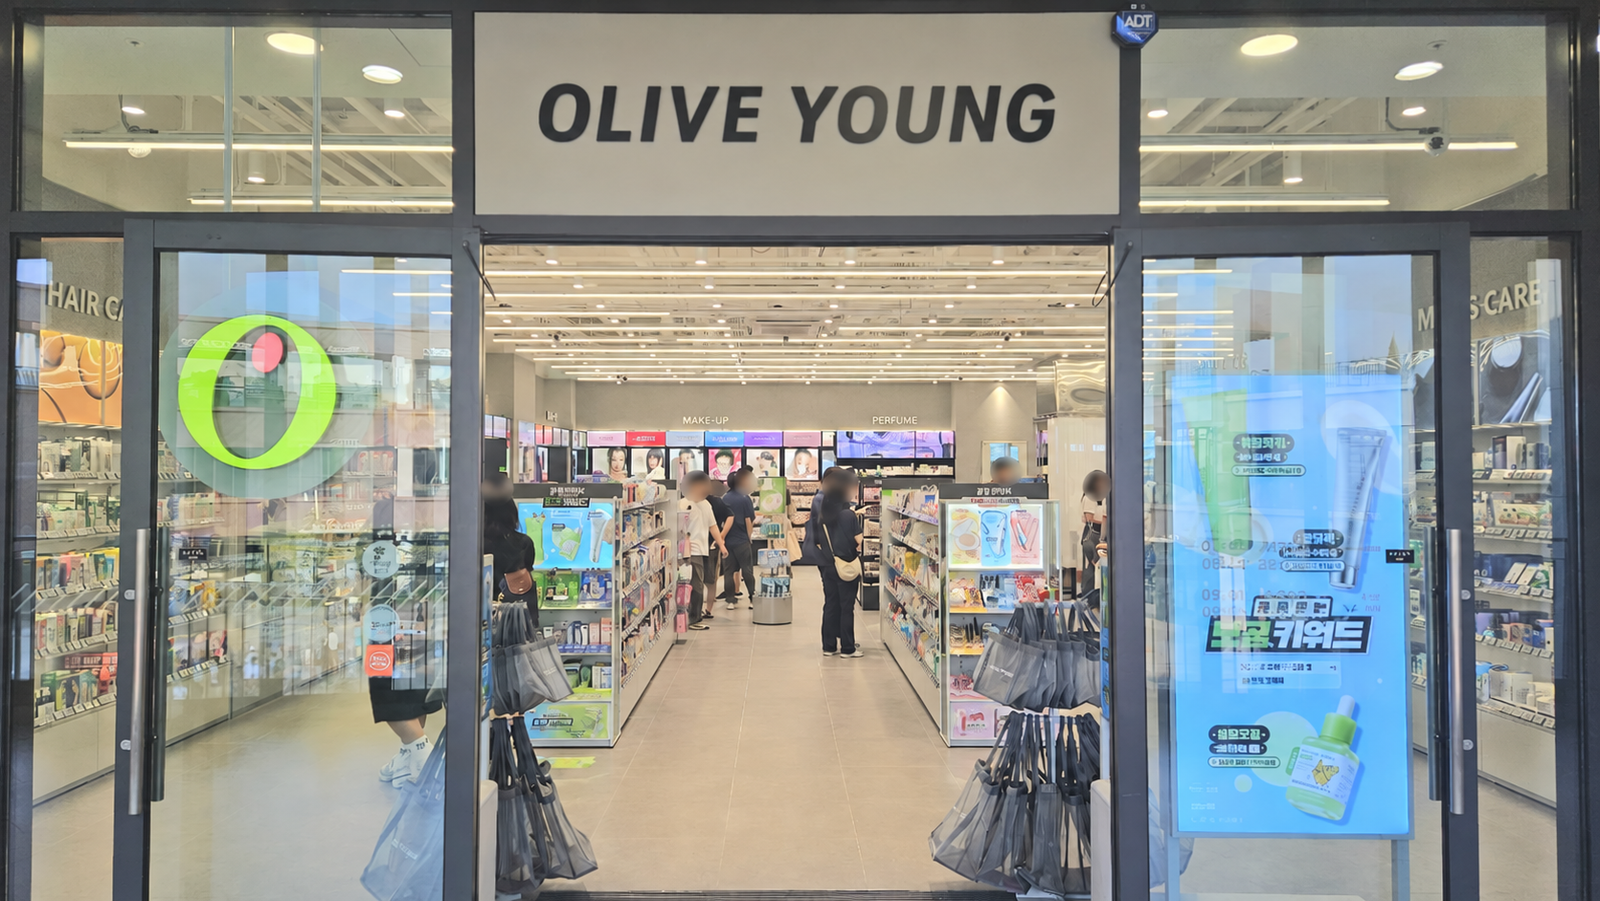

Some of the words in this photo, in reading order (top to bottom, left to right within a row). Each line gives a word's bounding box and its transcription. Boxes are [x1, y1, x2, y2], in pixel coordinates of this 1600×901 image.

[1124, 14, 1153, 28] ADT
[538, 83, 763, 143] OLIVE
[791, 83, 1056, 144] YOUNG
[47, 281, 100, 317] HAIR
[1484, 279, 1541, 316] CARE
[682, 416, 729, 425] MAKE-UP
[872, 416, 918, 425] PERFUME
